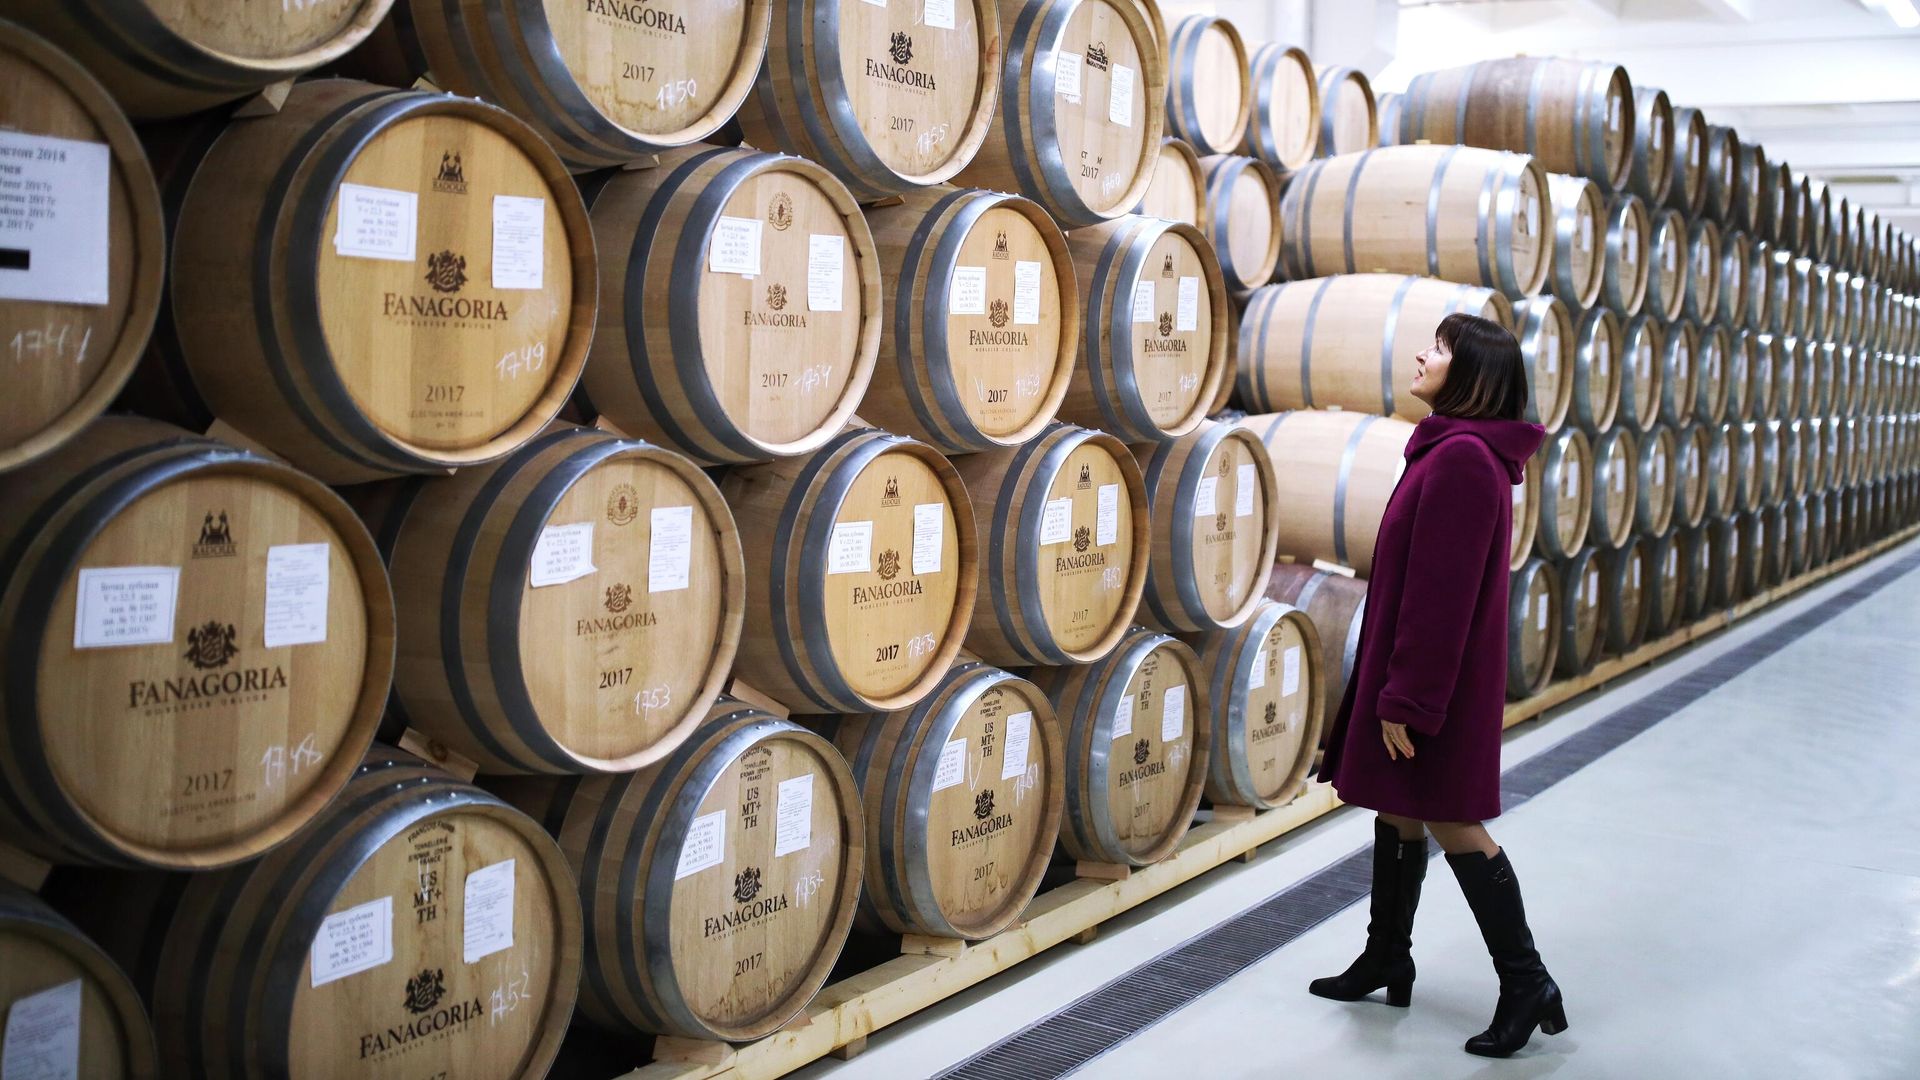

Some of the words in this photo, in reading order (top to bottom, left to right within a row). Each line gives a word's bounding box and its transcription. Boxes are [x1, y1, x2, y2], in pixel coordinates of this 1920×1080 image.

[586, 0, 686, 34] FANAGORIA
[622, 62, 655, 83] 2017
[866, 58, 936, 90] FANAGORIA
[656, 78, 697, 110] 1750
[891, 116, 914, 133] 2017
[1081, 164, 1099, 179] 2017
[383, 292, 508, 321] FANAGORIA
[744, 310, 807, 328] FANAGORIA
[969, 329, 1029, 346] FANAGORIA
[1144, 338, 1187, 353] FANAGORIA
[495, 341, 545, 381] 1749
[762, 373, 789, 388] 2017
[425, 385, 465, 402] 2017
[988, 389, 1008, 403] 2017
[1056, 553, 1105, 573] FANAGORIA
[853, 580, 922, 605] FANAGORIA
[577, 612, 657, 636] FANAGORIA
[876, 644, 899, 662] 2017
[128, 665, 287, 709] FANAGORIA
[600, 668, 632, 689] 2017
[634, 685, 670, 720] 1753
[984, 722, 994, 734] US
[983, 746, 992, 758] TH
[183, 769, 233, 796] 2017
[1119, 761, 1165, 788] FANAGORIA
[747, 786, 759, 802] US
[744, 815, 758, 830] TH
[951, 812, 1012, 847] FANAGORIA
[974, 861, 994, 881] 2017
[417, 905, 436, 924] TH
[704, 893, 788, 938] FANAGORIA
[735, 952, 762, 977] 2017
[359, 997, 484, 1060] FANAGORIA
